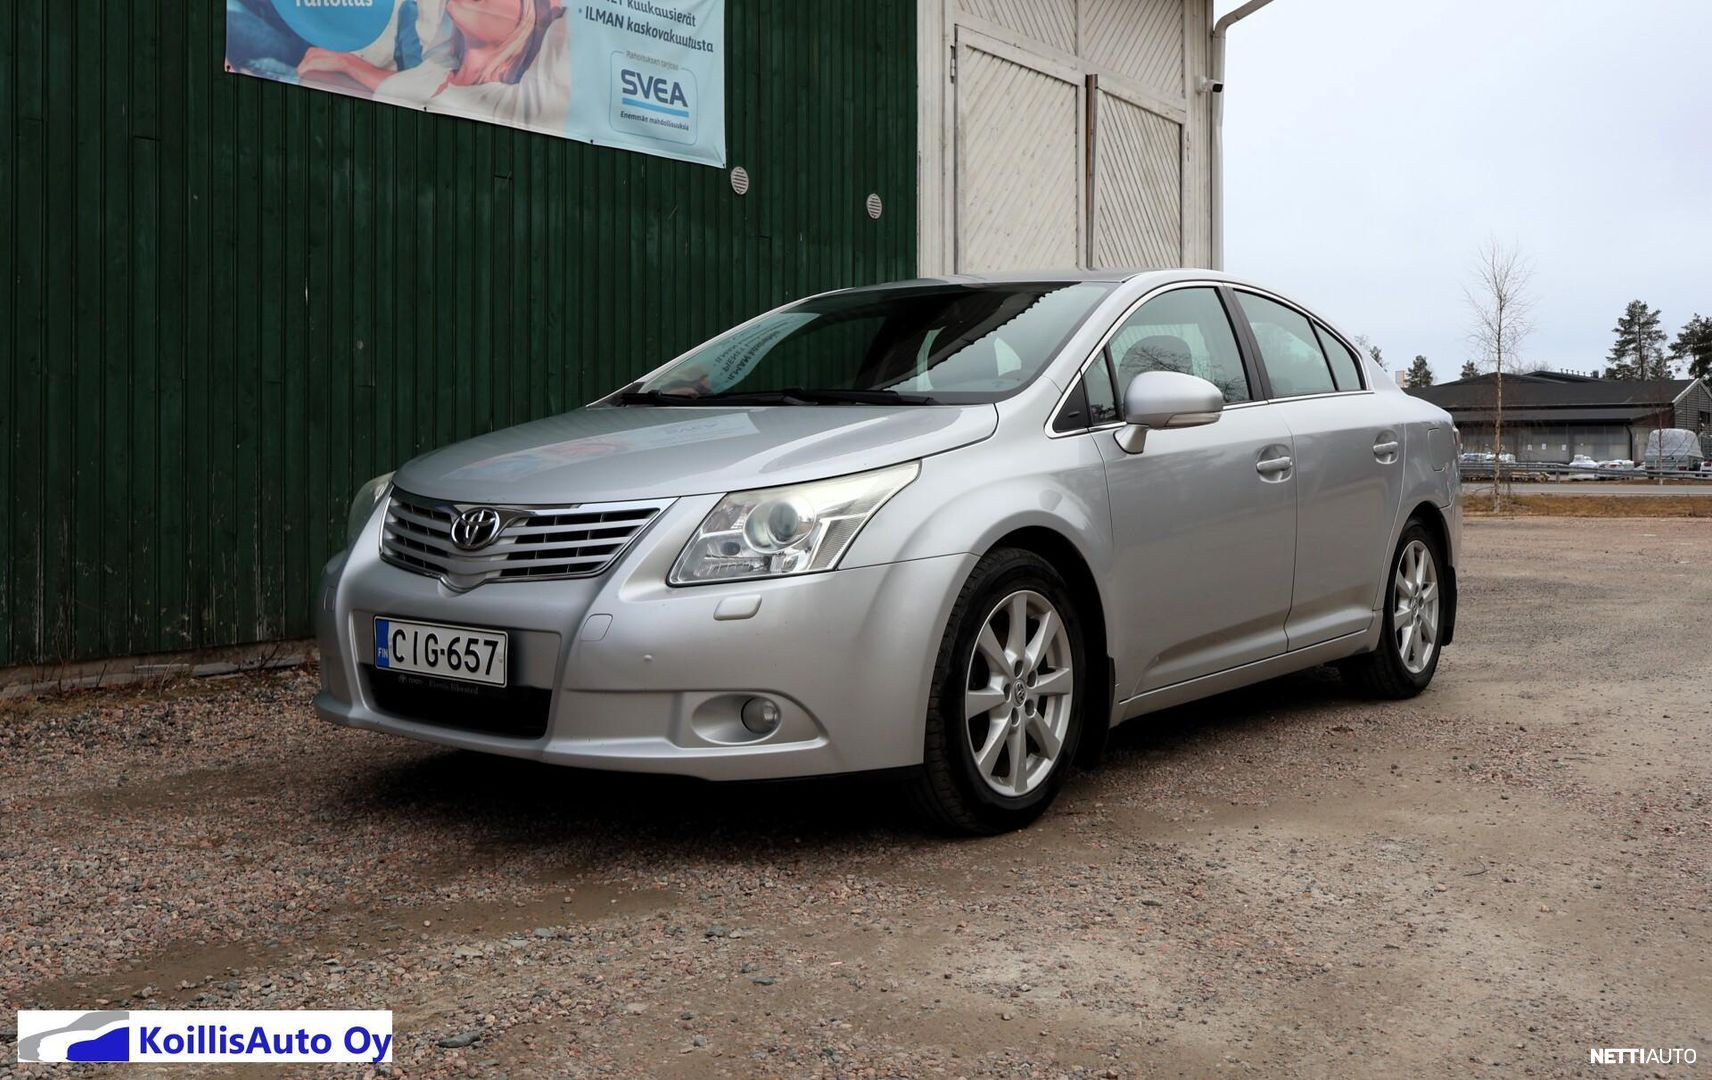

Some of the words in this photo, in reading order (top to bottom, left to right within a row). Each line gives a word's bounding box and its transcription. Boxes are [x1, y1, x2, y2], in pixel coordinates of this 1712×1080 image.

[585, 6, 624, 29] ILMAN
[626, 16, 714, 53] kaskovakuutusta
[621, 69, 688, 107] SVEA
[620, 110, 648, 122] Enemmän
[378, 647, 389, 658] FIN
[392, 629, 499, 675] CIG-657
